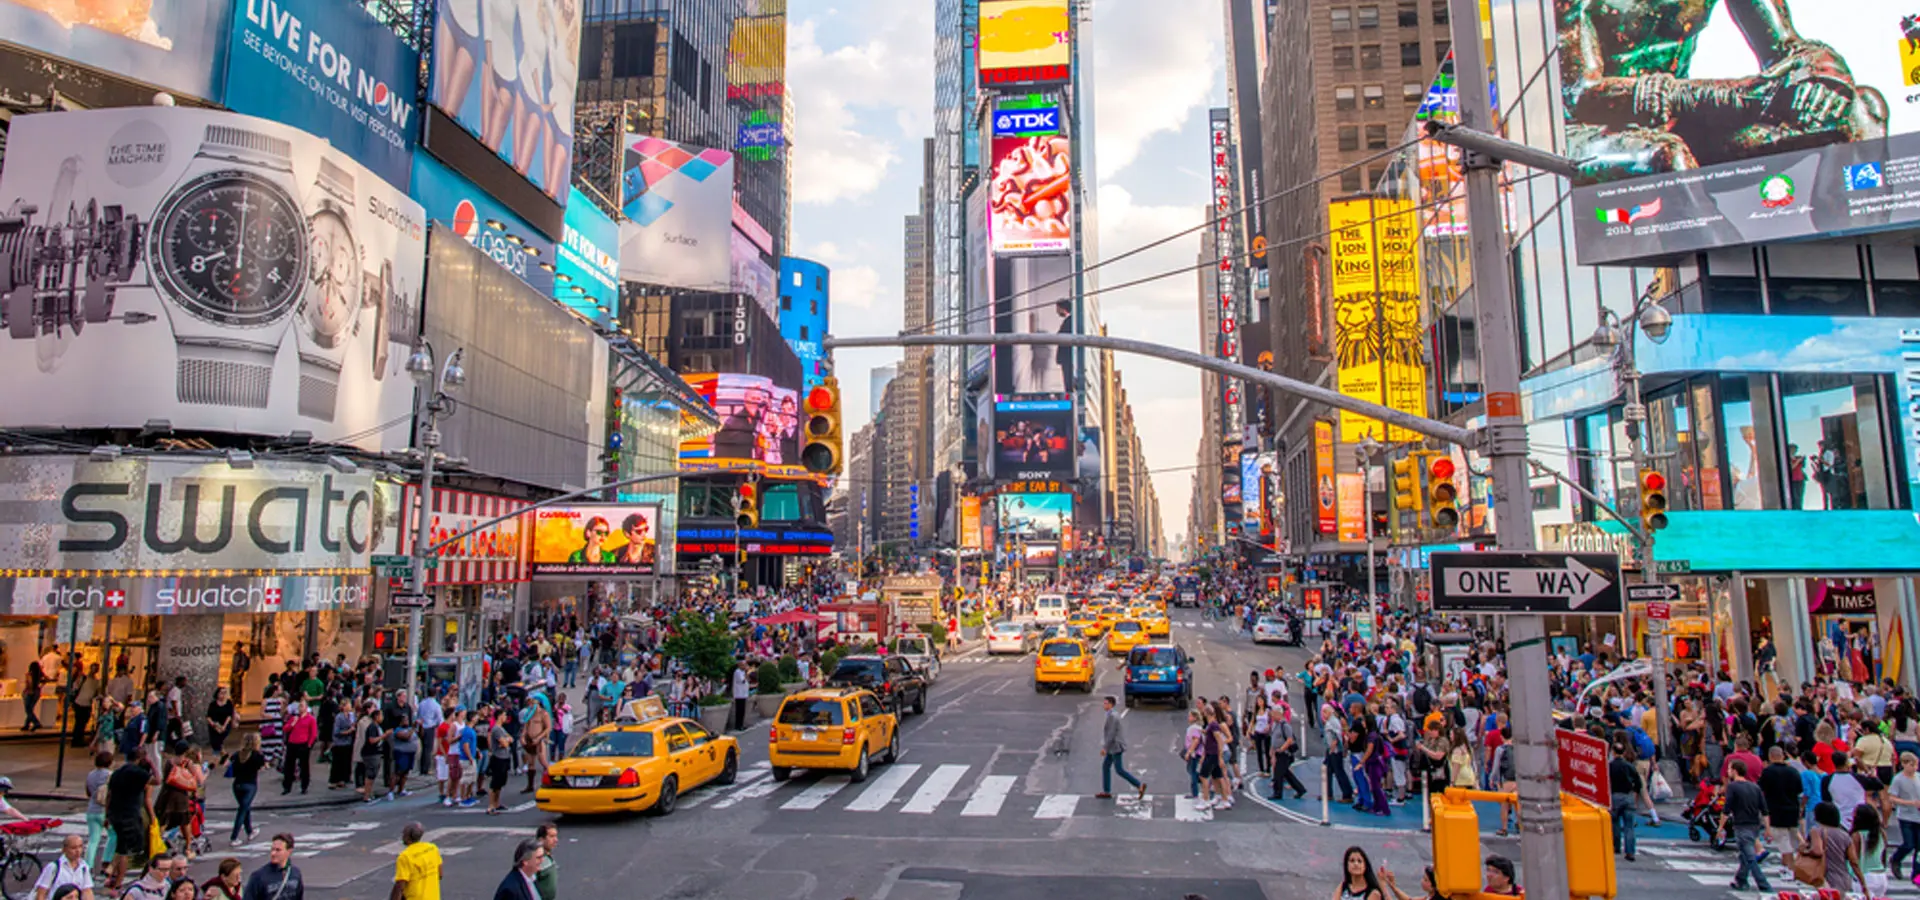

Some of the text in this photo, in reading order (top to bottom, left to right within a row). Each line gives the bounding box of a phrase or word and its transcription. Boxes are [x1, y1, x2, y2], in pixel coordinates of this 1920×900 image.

[247, 0, 413, 129] LIVE FOR NOW
[980, 64, 1068, 83] TOSHIBA
[243, 29, 261, 53] SEE
[308, 76, 325, 96] ON
[350, 105, 368, 125] VISIT
[368, 115, 405, 150] PEPSI.COM
[1010, 112, 1055, 128] TDK
[1215, 132, 1228, 232] ERNST
[1597, 189, 1616, 198] Under
[1617, 187, 1627, 195] the
[1656, 180, 1665, 188] of
[1665, 178, 1675, 187] the
[1706, 171, 1714, 180] of
[1715, 169, 1736, 178] Italian
[1736, 164, 1767, 176] Republic
[368, 195, 411, 237] swatch
[664, 233, 698, 247] Surface
[1340, 229, 1360, 240] THE
[1336, 242, 1366, 256] LION
[1335, 259, 1370, 276] KING
[1221, 294, 1238, 405] YOUG
[1018, 471, 1051, 479] SONY
[539, 511, 581, 519] CARRERA
[1459, 571, 1590, 595] ONE WAY
[13, 584, 104, 609] swatch
[156, 584, 264, 609] swatch
[305, 584, 361, 606] swatch
[1832, 594, 1874, 609] TIMES
[1561, 738, 1603, 761] NO STOPPING
[1570, 758, 1597, 778] ANYTIME
